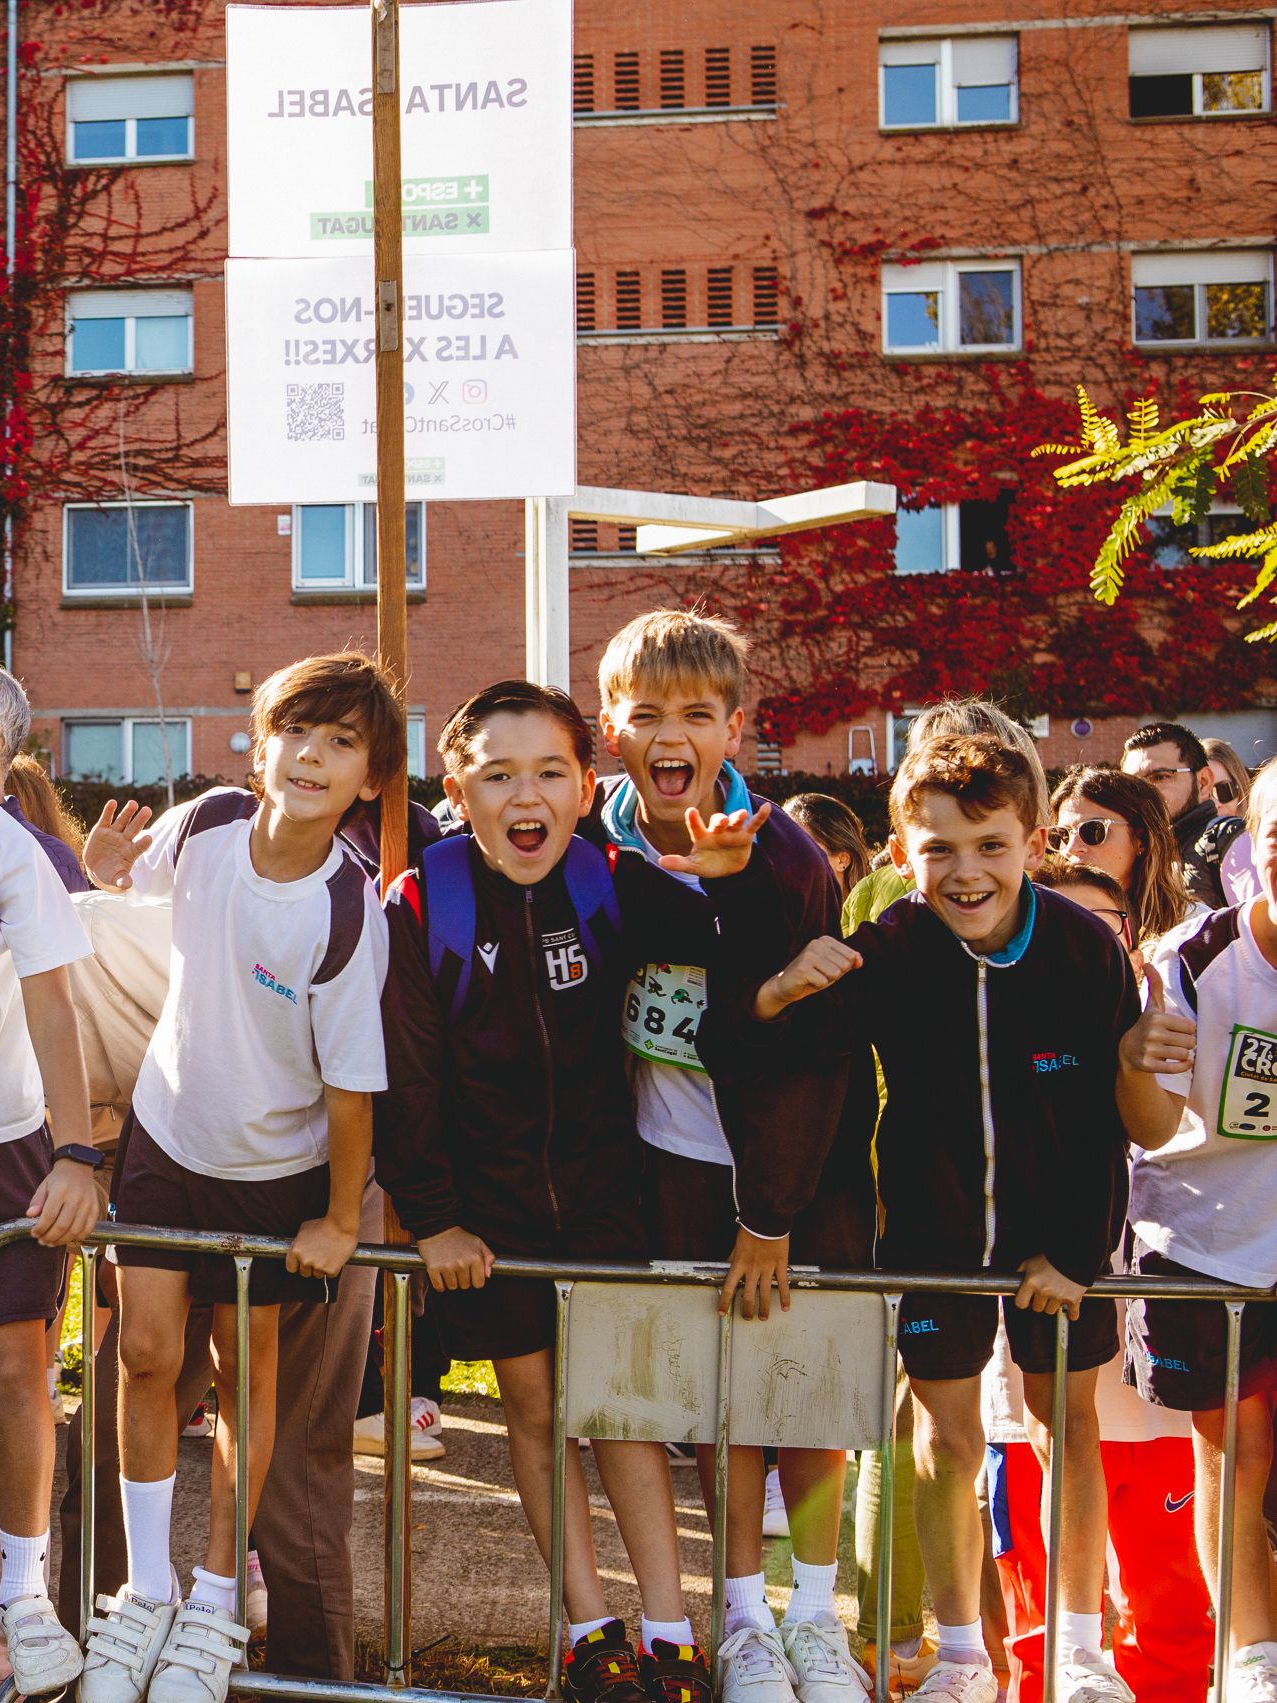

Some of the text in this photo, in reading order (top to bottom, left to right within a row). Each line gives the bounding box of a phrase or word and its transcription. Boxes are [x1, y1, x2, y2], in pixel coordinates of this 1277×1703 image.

[254, 963, 276, 981] SANTA
[1243, 1091, 1271, 1117] 2
[131, 1596, 154, 1611] Polo
[190, 1603, 212, 1614] Polo
